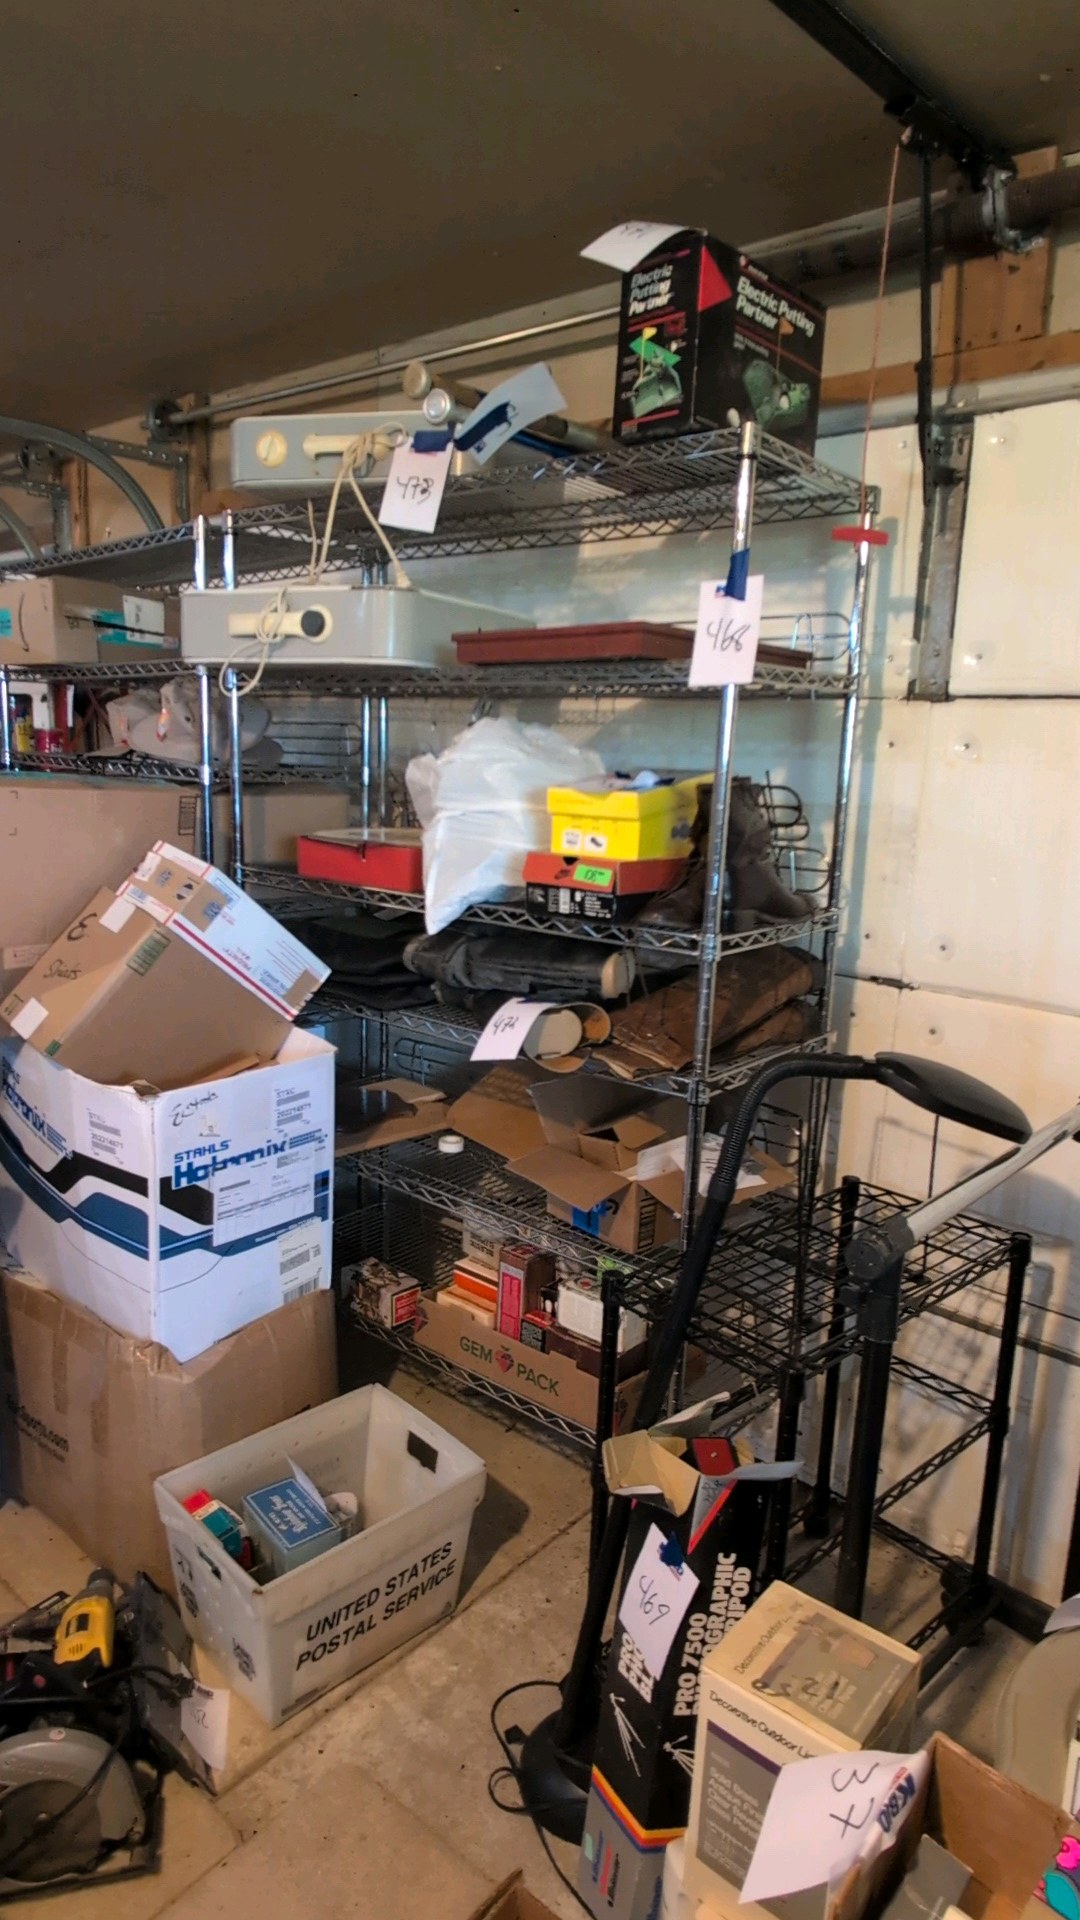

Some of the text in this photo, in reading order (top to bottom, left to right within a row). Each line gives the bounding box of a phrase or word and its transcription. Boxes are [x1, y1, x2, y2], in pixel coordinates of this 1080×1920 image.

[630, 278, 671, 302] Putting
[631, 264, 673, 289] Electric
[736, 294, 778, 329] Partner
[737, 275, 816, 338] Electric Putting
[706, 617, 751, 652] 468
[174, 1139, 232, 1163] STAHLS
[459, 1336, 559, 1397] GEM PACK
[295, 1614, 377, 1671] POSTAL
[382, 1558, 457, 1621] SERVICE
[306, 1541, 453, 1642] UNITED STATES
[639, 1575, 671, 1626] 469
[673, 1612, 708, 1716] PRO 7500
[709, 1690, 758, 1729] Decorative
[757, 1721, 798, 1751] Outdoor
